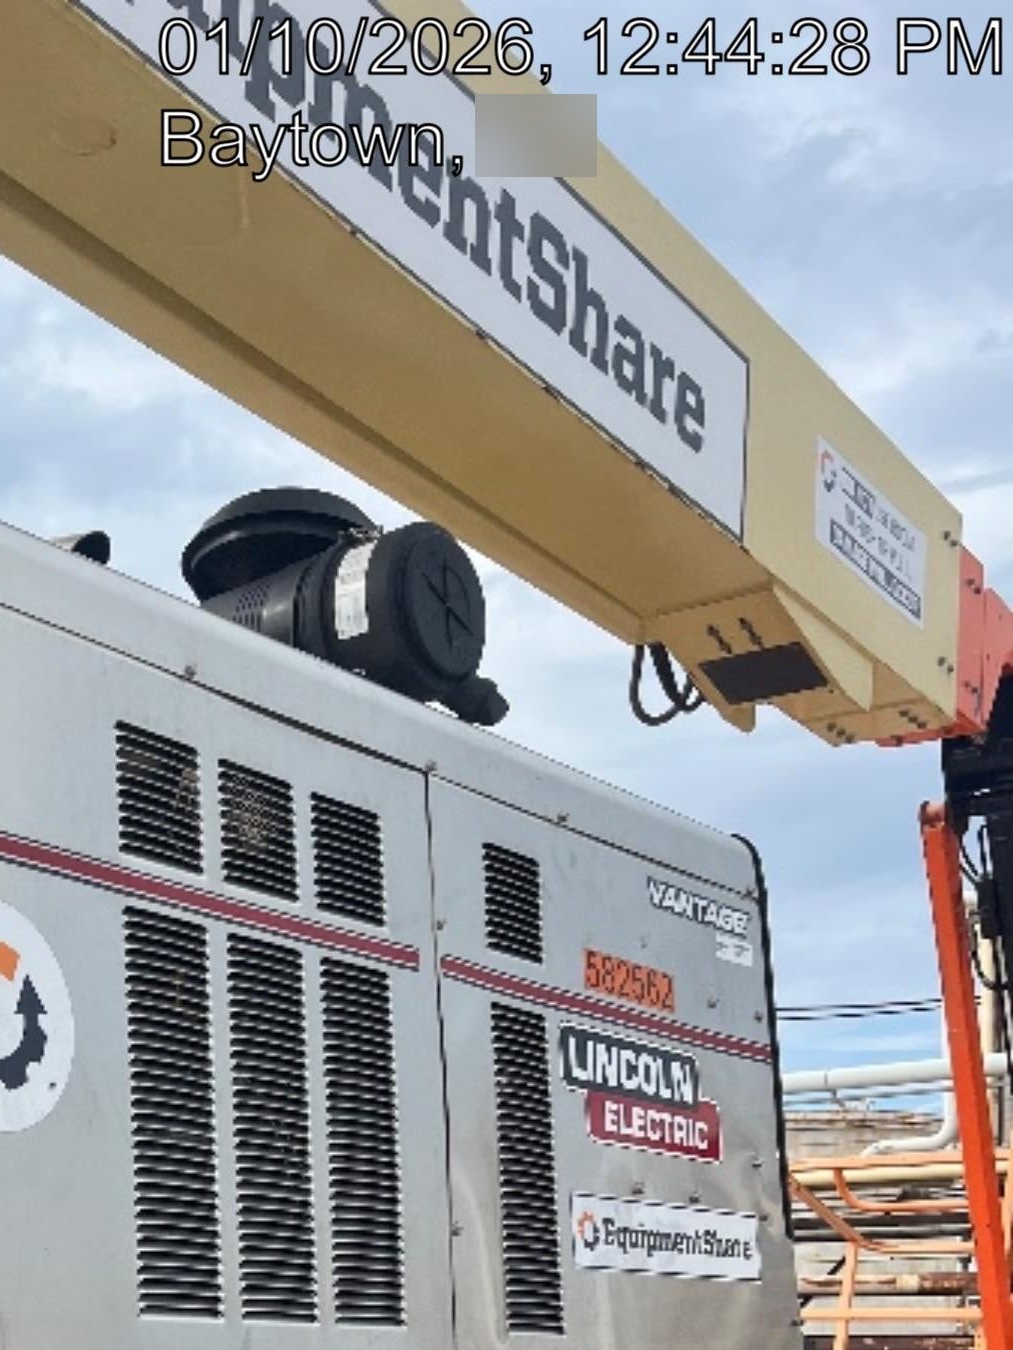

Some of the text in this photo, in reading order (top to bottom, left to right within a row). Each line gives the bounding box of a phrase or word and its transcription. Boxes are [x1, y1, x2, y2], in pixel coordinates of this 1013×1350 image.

[647, 876, 751, 939] VANTAGE
[585, 950, 674, 1009] 582562
[568, 1034, 694, 1105] LINCOLN
[603, 1099, 709, 1151] ELECTRIC
[601, 1217, 754, 1261] EquipmentShare
